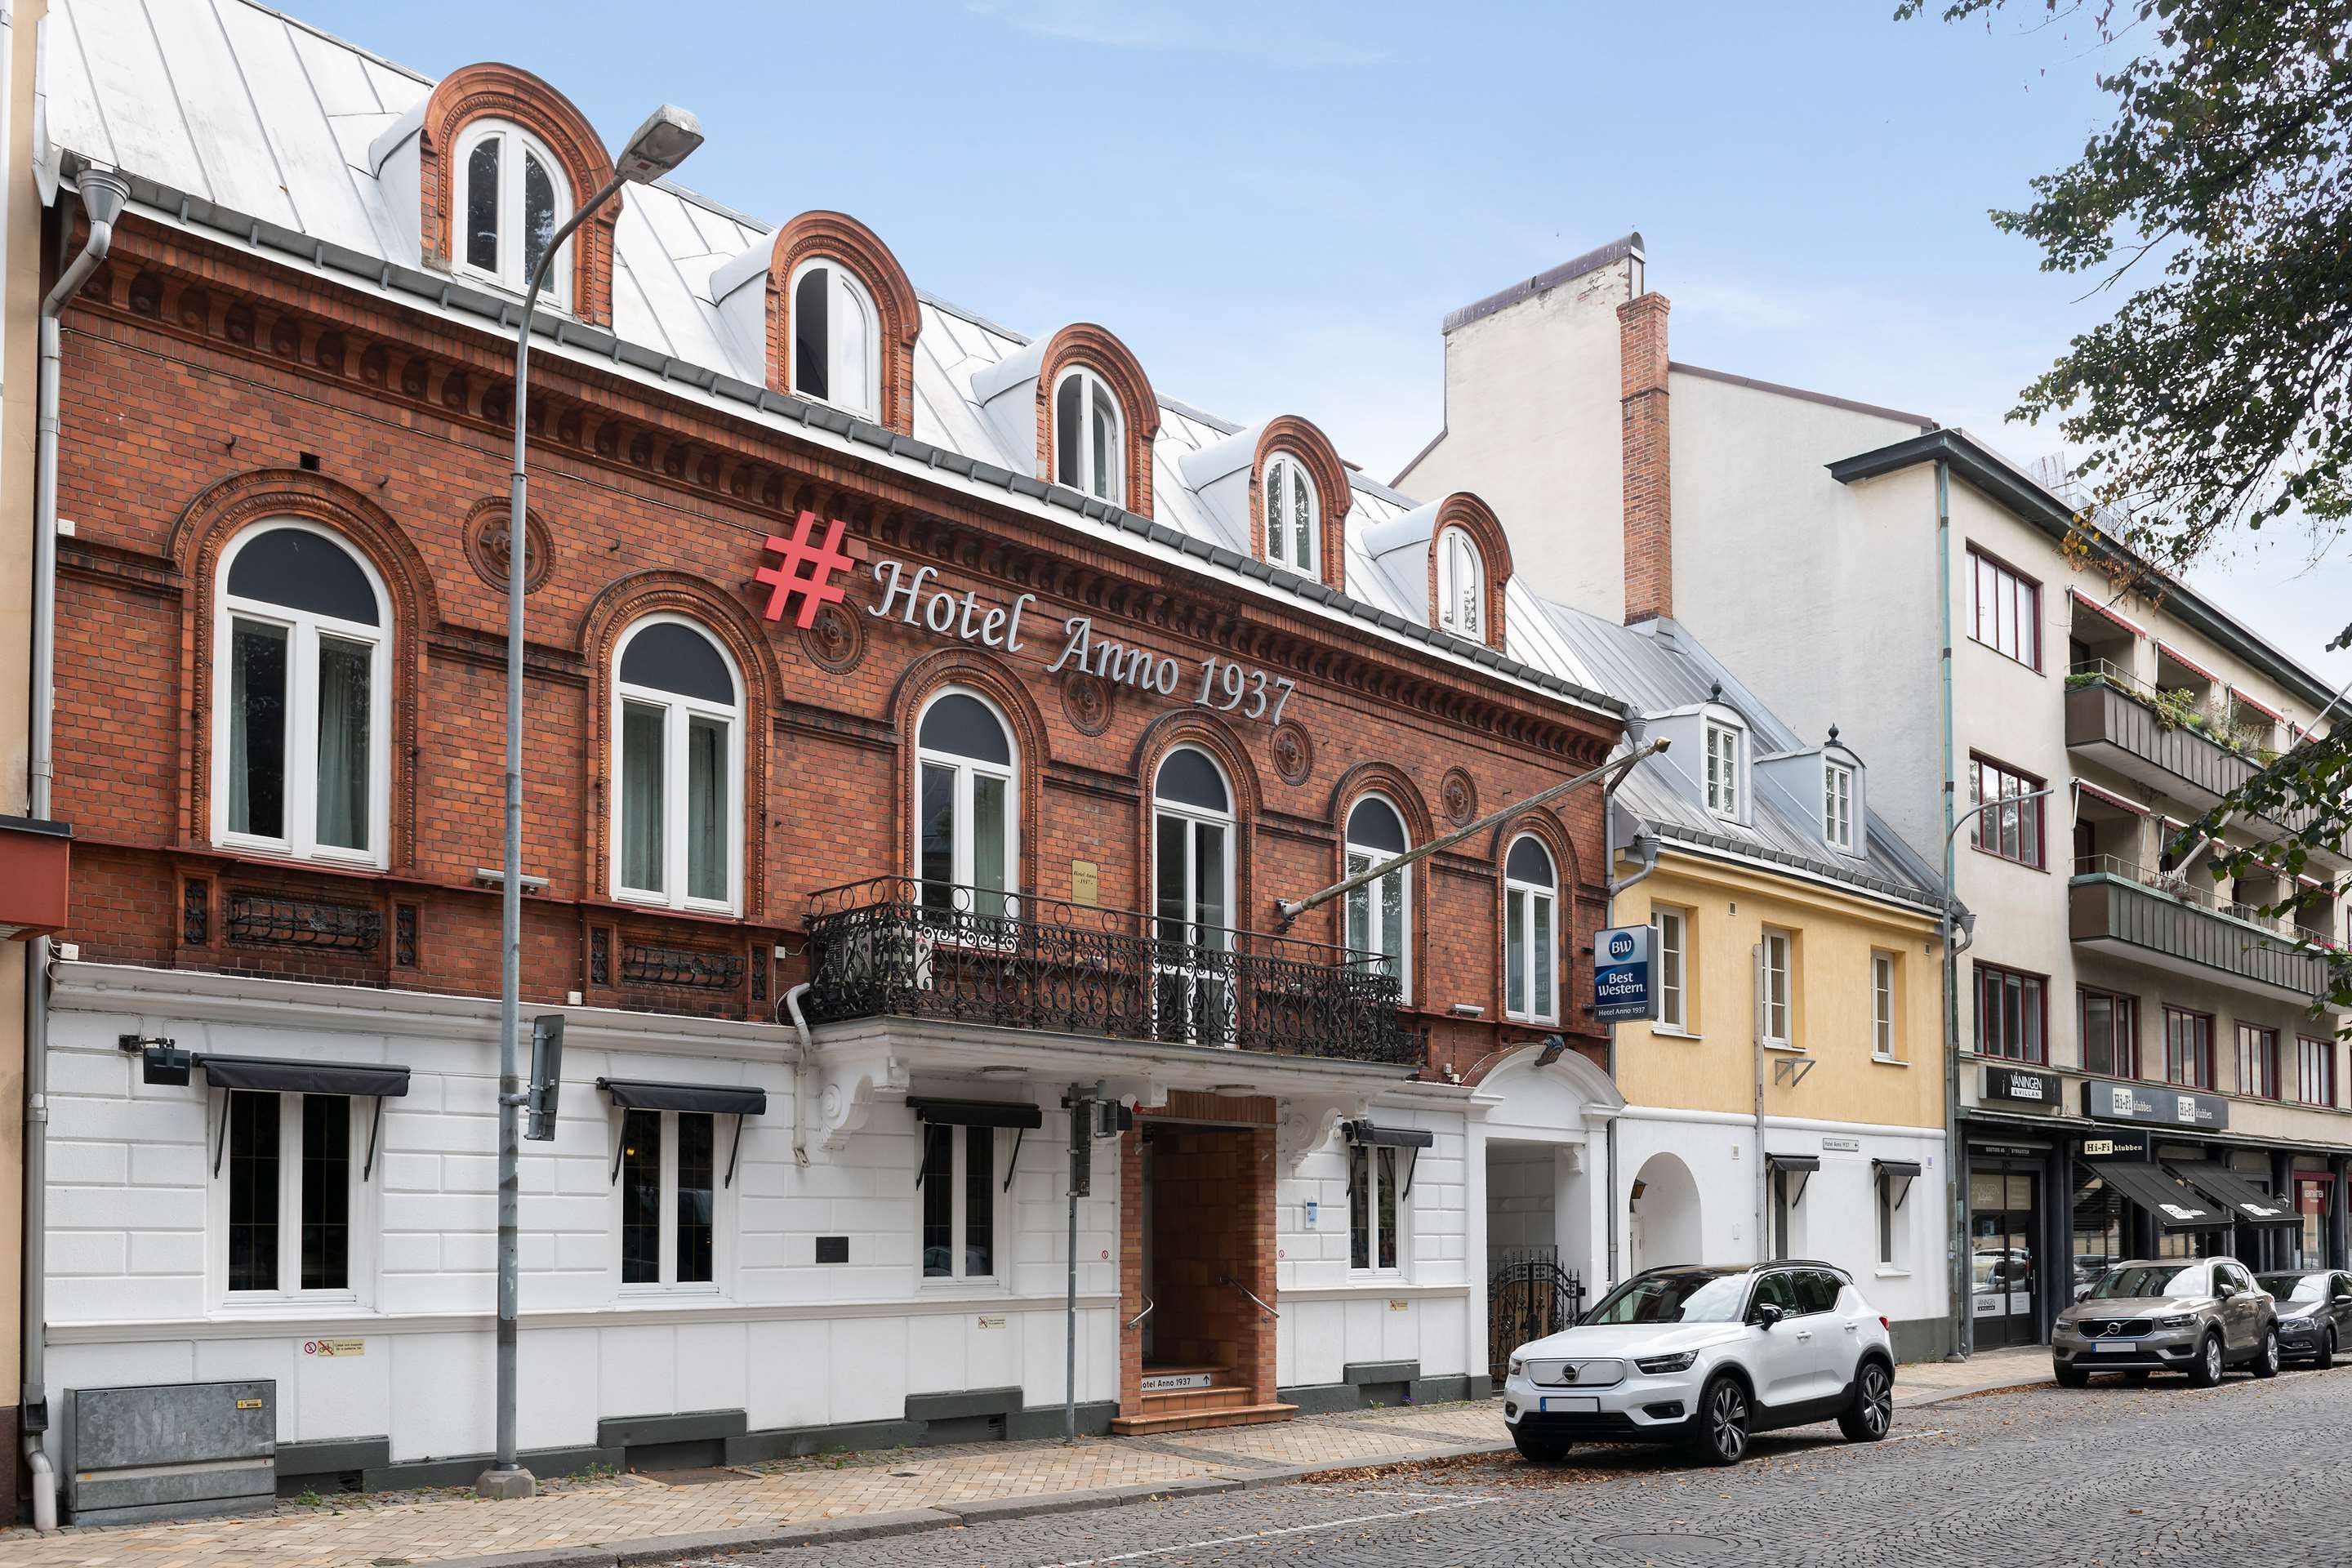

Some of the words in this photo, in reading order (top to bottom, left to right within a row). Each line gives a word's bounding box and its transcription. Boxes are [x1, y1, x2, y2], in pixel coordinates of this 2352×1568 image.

[867, 559, 1036, 653] Hotel
[1047, 617, 1179, 695] Anno
[1195, 656, 1295, 725] 1937
[1611, 940, 1633, 954] BW
[1609, 972, 1633, 984] Best
[1598, 983, 1643, 996] Western
[1598, 1009, 1615, 1017] Hotel
[1615, 1007, 1631, 1015] Anno
[2114, 1094, 2132, 1111] Hi-Fi
[2133, 1100, 2153, 1112] klubben
[2179, 1102, 2194, 1117] Hi-Fi
[2195, 1108, 2212, 1120] klubben
[2087, 1143, 2110, 1152] Hi-Fi
[1141, 1380, 1156, 1388] otel
[1158, 1379, 1174, 1388] Anno
[1176, 1378, 1191, 1386] 1937
